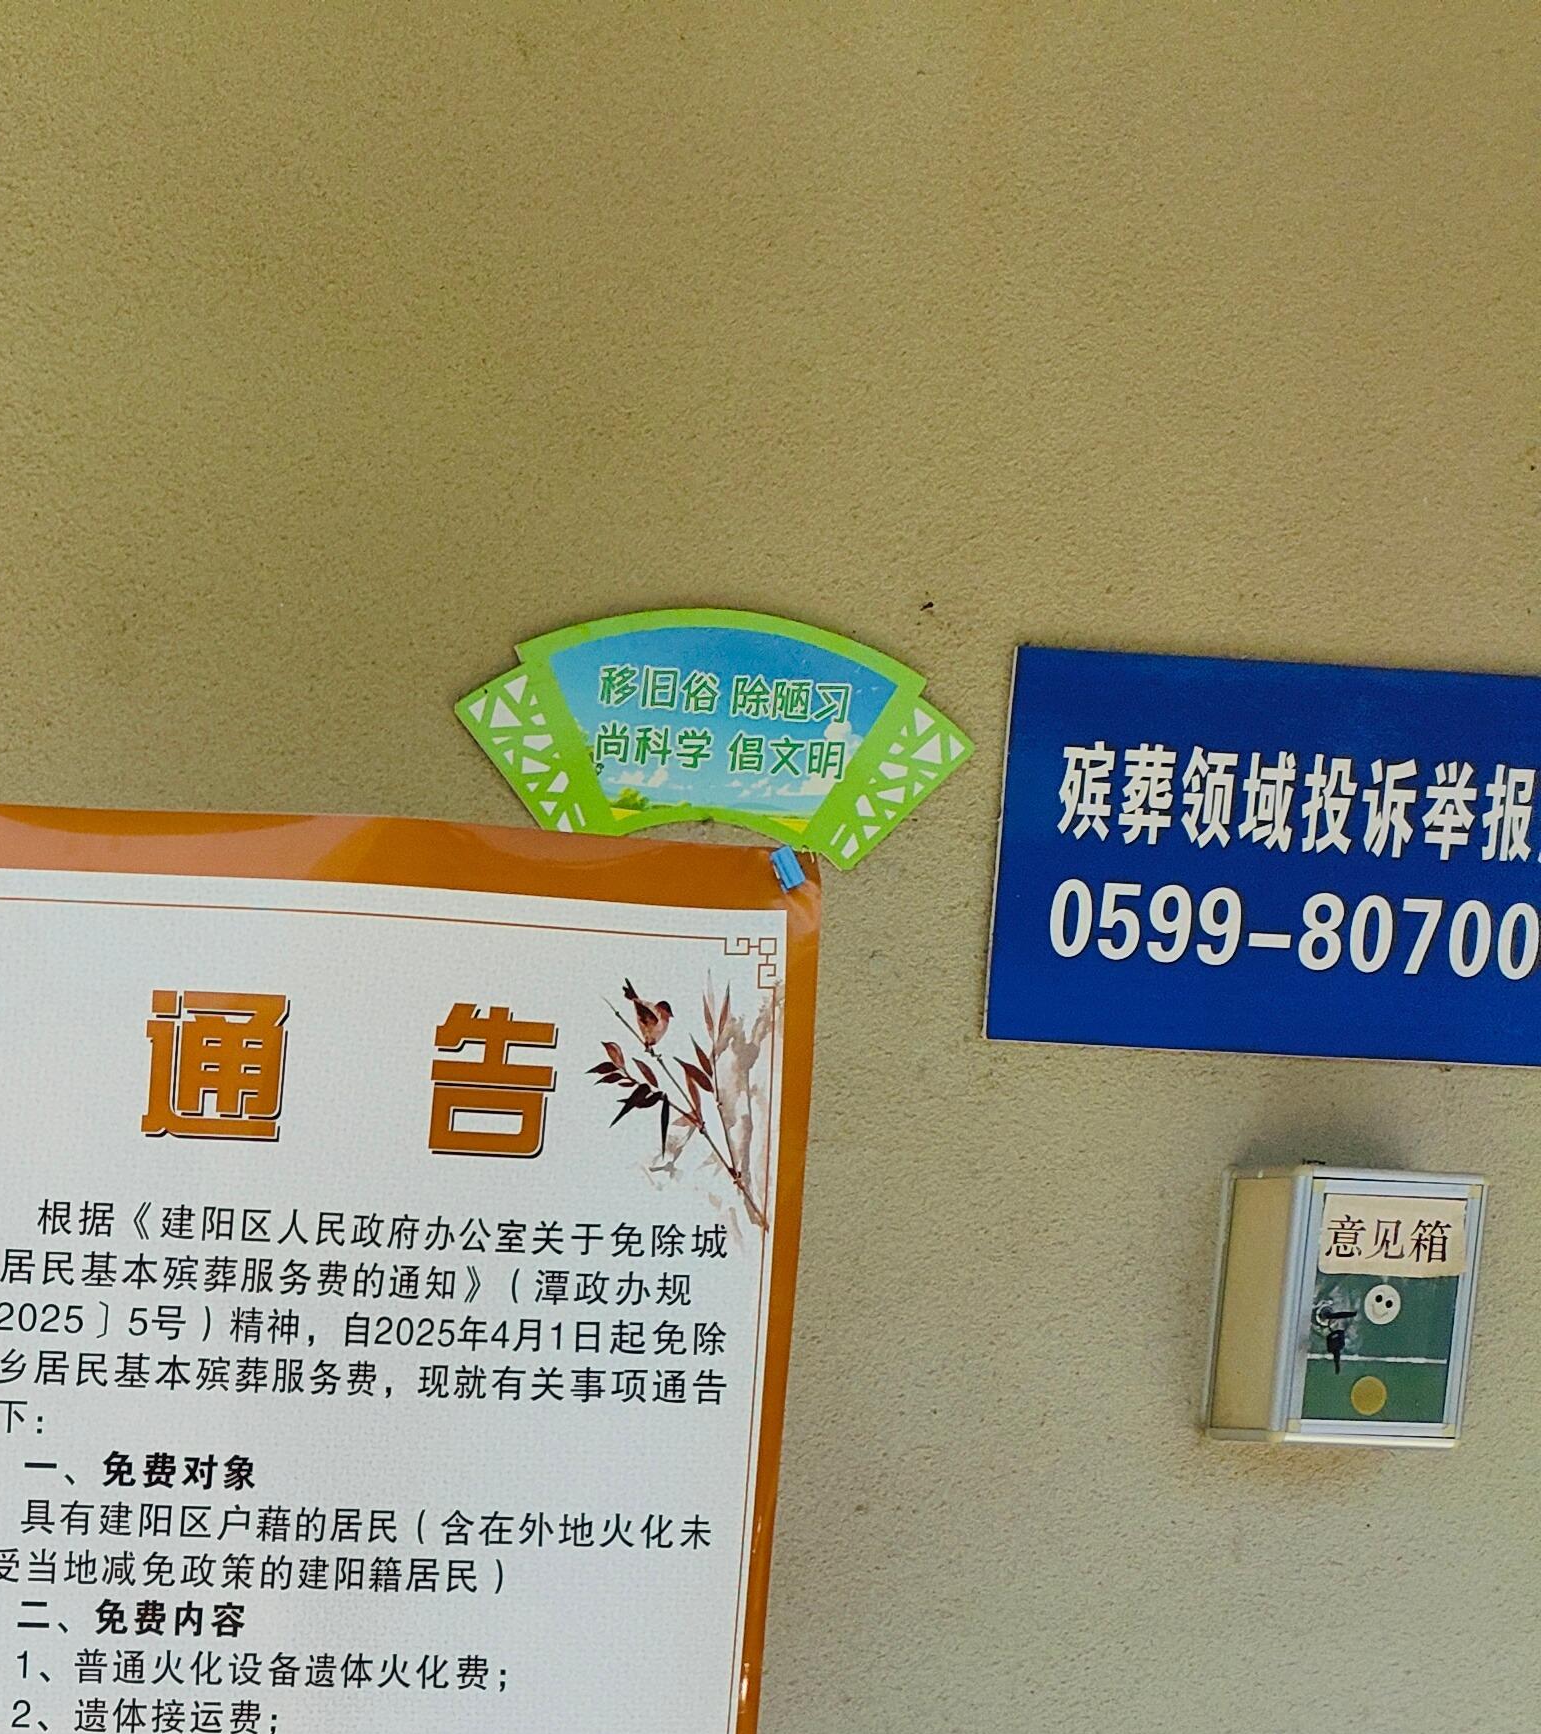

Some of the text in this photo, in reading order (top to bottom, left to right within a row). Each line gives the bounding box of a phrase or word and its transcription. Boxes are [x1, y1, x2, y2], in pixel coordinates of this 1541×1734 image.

[599, 665, 851, 723] 移旧俗 除陋习
[594, 722, 846, 780] 尚科学 倡文明
[1057, 740, 1540, 863] 殡葬领域投诉举报
[141, 989, 558, 1158] 通告
[1325, 1214, 1453, 1264] 意见箱
